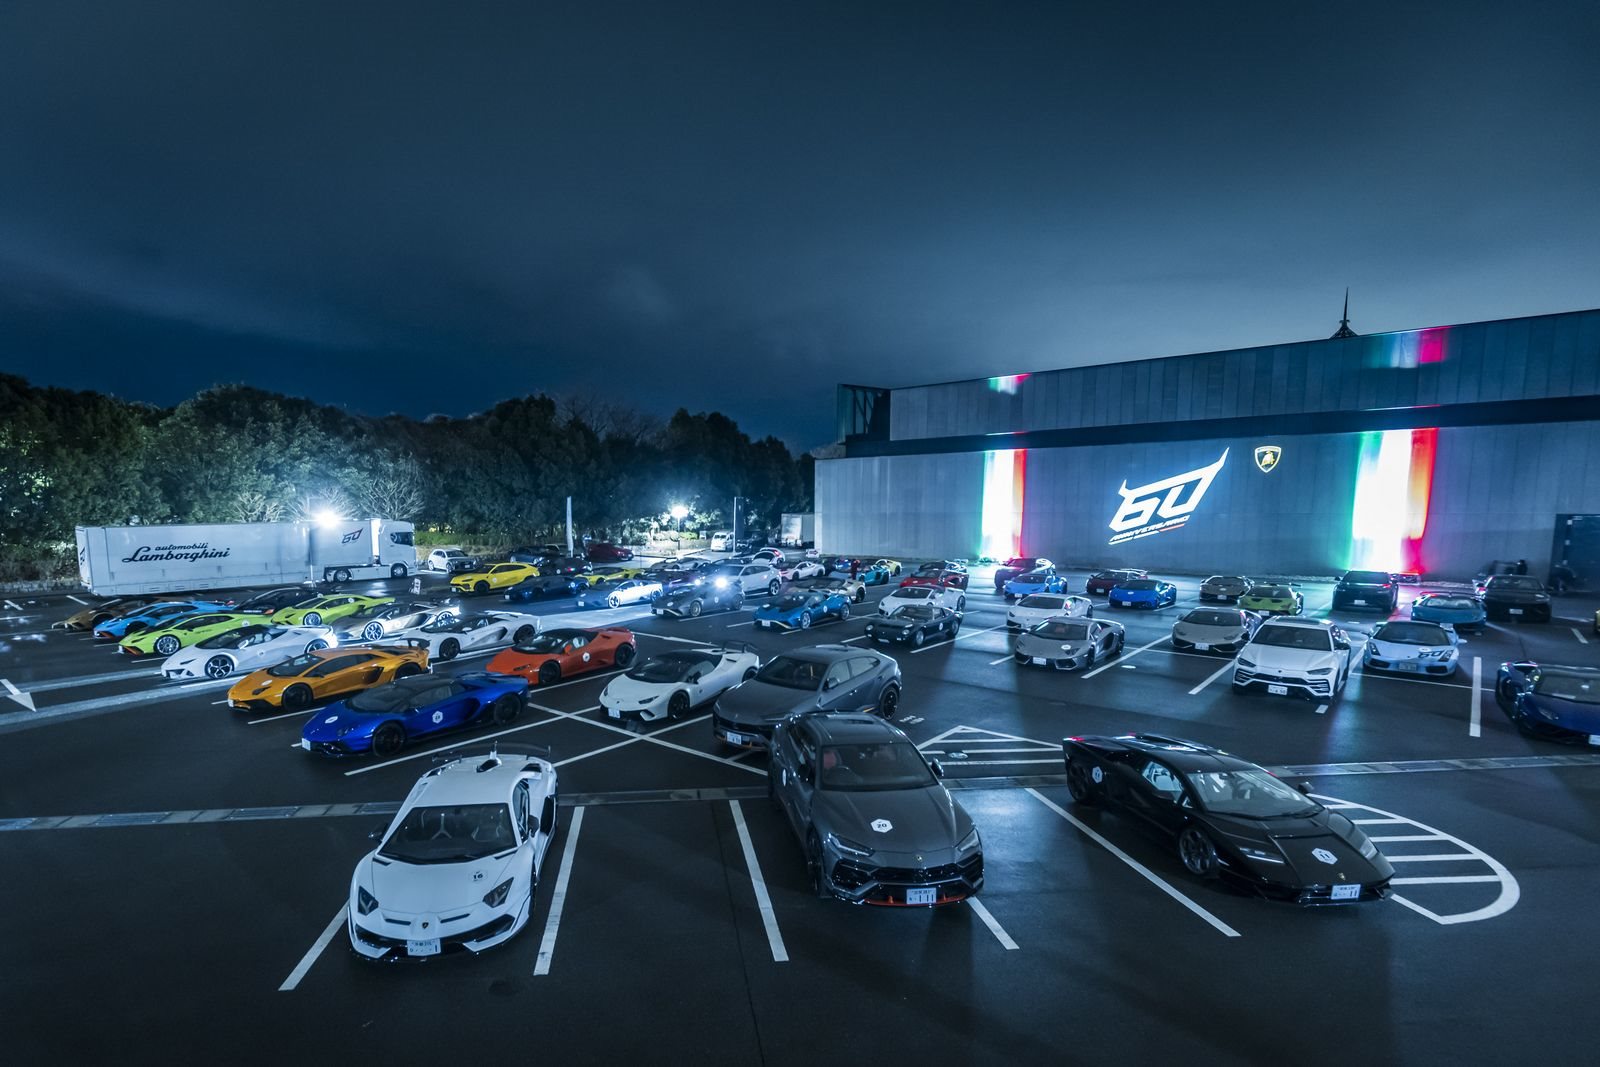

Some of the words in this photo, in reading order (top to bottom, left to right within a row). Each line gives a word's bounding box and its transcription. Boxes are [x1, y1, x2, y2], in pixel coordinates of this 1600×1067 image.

[1109, 446, 1230, 533] 60
[341, 527, 364, 544] 60
[121, 545, 230, 563] Lamborghini
[154, 542, 208, 551] automobili
[473, 872, 484, 880] 16
